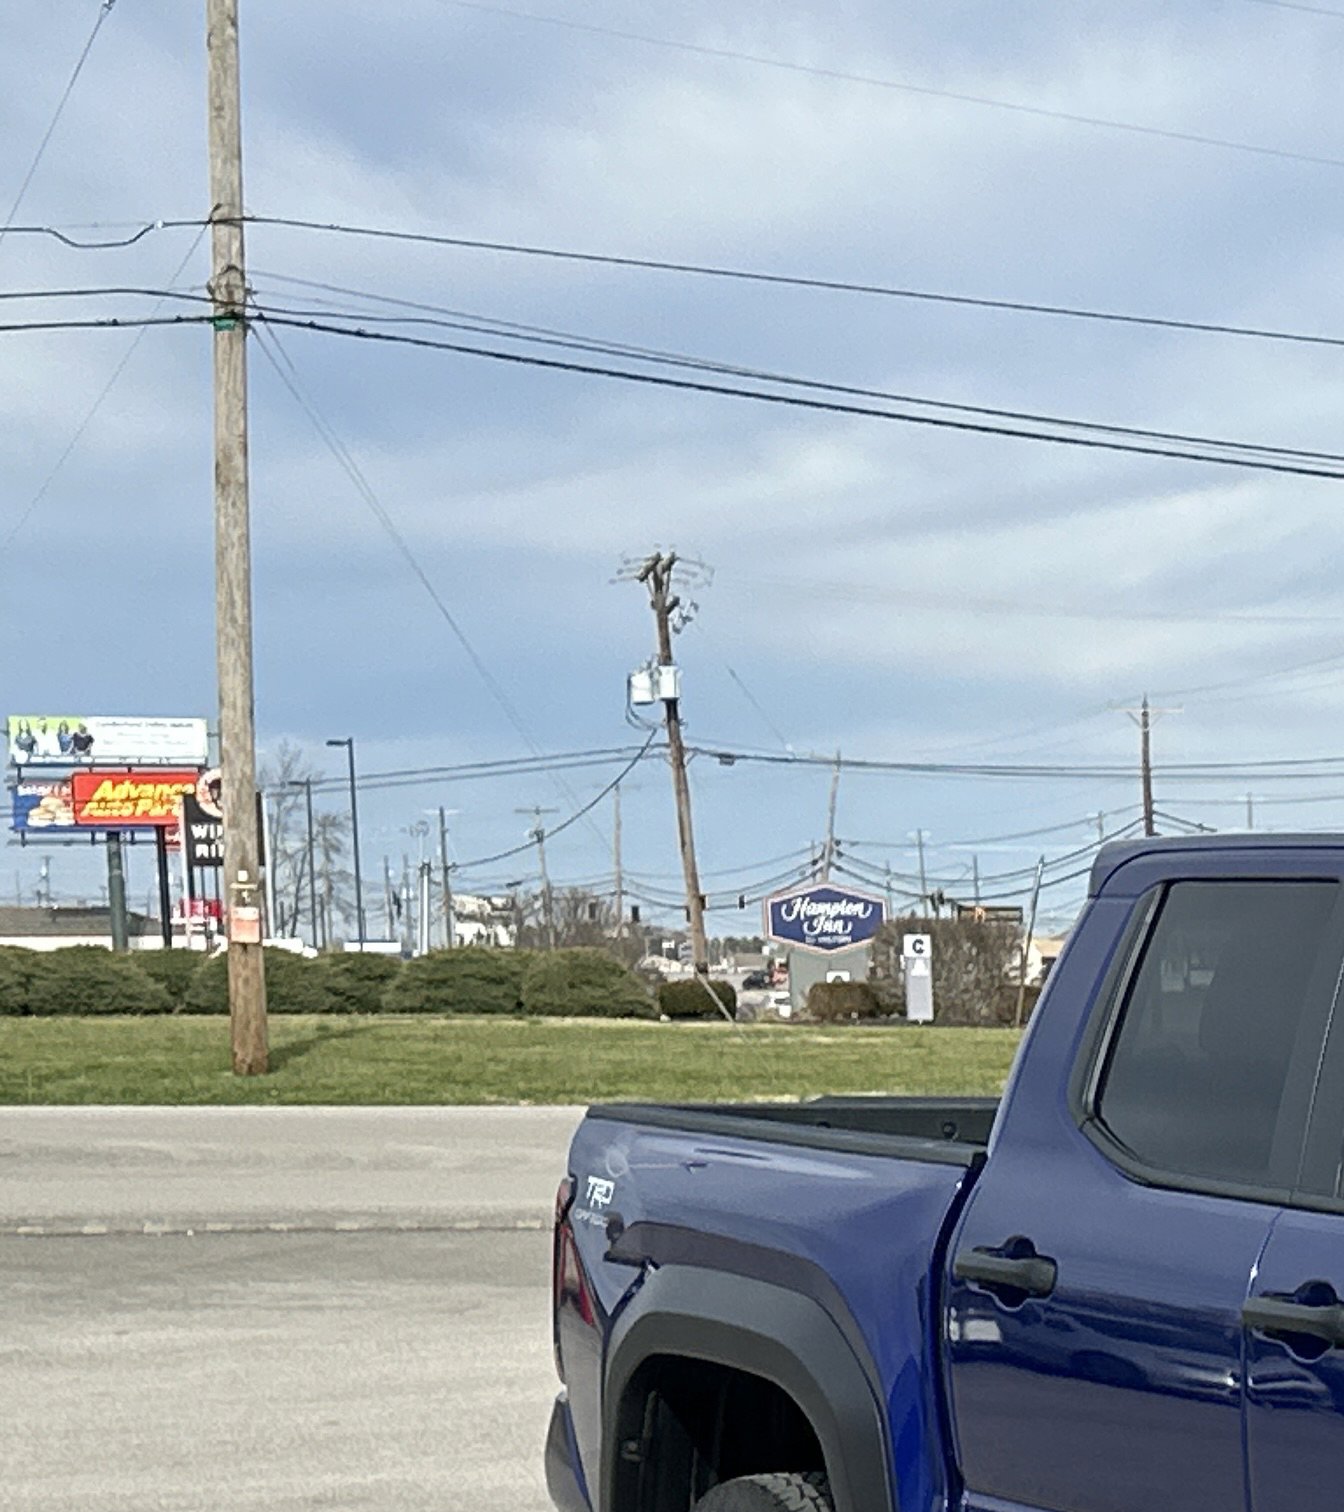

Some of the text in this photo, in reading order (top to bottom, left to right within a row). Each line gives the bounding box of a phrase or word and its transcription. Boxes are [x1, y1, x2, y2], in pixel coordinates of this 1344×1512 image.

[92, 779, 195, 801] Advance
[80, 800, 135, 817] Auto
[781, 896, 873, 922] Hampton
[803, 916, 853, 936] Inn
[912, 938, 924, 954] C
[586, 1175, 615, 1210] TRD
